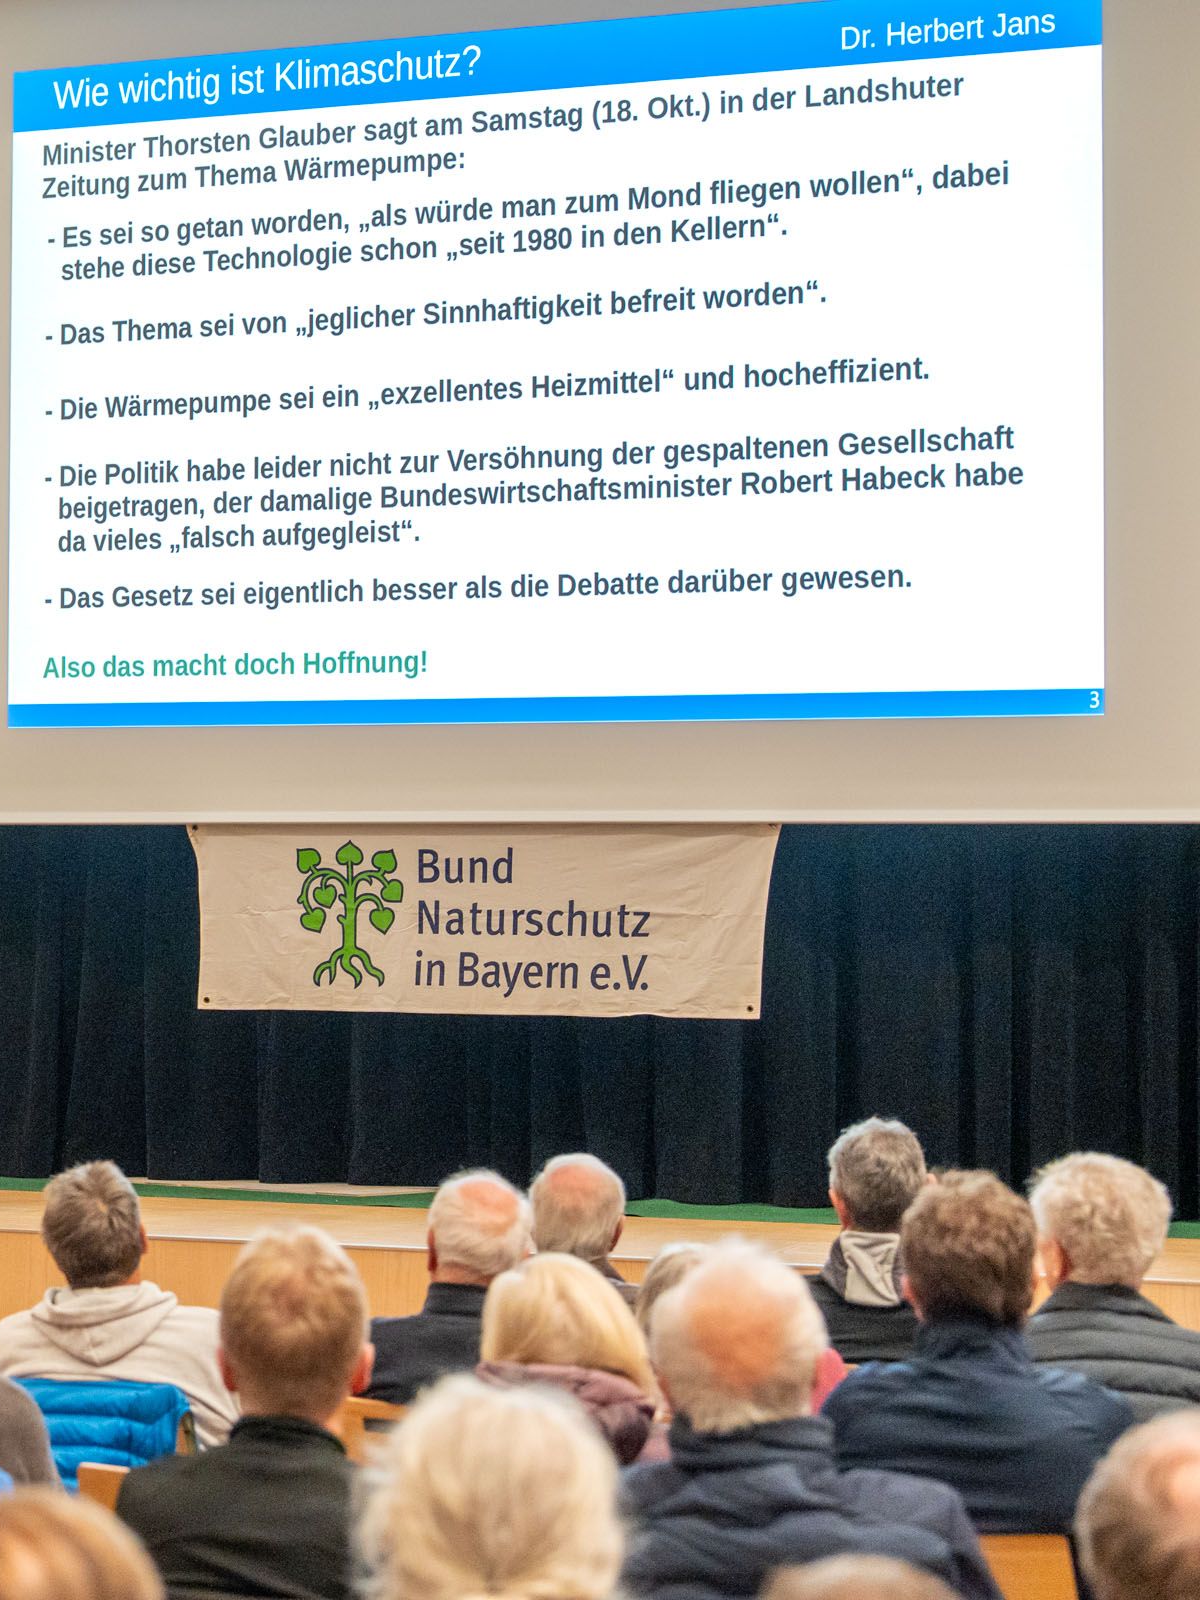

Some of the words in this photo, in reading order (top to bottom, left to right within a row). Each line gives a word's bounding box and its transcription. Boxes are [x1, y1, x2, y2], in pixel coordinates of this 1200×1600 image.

[841, 26, 875, 50] Dr.
[887, 16, 984, 46] Herbert
[992, 13, 1056, 38] Jans
[53, 77, 109, 109] Wie
[118, 67, 220, 105] wichtig
[231, 65, 265, 95] ist
[275, 44, 481, 92] Klimaschutz?
[43, 140, 137, 167] Minister
[142, 131, 251, 159] Thorsten
[258, 122, 357, 149] Glauber
[363, 116, 418, 146] sagt
[424, 116, 463, 137] am
[471, 105, 583, 134] Samstag
[592, 99, 639, 131] (18.
[647, 91, 711, 123] Okt.)
[720, 90, 744, 115] in
[752, 86, 797, 112] der
[805, 75, 965, 108] Landshuter
[42, 174, 130, 200] Zeitung
[137, 171, 187, 192] zum
[194, 163, 278, 188] Thema
[283, 151, 465, 182] Wärmepumpe:
[63, 225, 92, 248] Es
[99, 220, 133, 246] sei
[140, 224, 170, 243] so
[176, 217, 244, 247] getan
[250, 208, 350, 236] worden,
[359, 203, 407, 233] „als
[414, 196, 494, 225] würde
[501, 197, 556, 219] man
[564, 193, 619, 215] zum
[628, 181, 701, 211] Mond
[709, 178, 801, 209] fliegen
[809, 167, 923, 198] wollen“,
[932, 159, 1009, 190] dabei
[61, 255, 125, 281] stehe
[132, 252, 196, 277] diese
[202, 240, 353, 272] Technologie
[360, 236, 437, 263] schon
[446, 230, 505, 262] „seit
[513, 226, 573, 253] 1980
[581, 224, 605, 249] in
[613, 221, 662, 247] den
[671, 212, 788, 243] Kellern“.
[60, 323, 105, 346] Das
[111, 318, 193, 343] Thema
[199, 312, 235, 338] sei
[241, 315, 287, 336] von
[295, 304, 416, 338] „jeglicher
[423, 291, 603, 325] Sinnhaftigkeit
[610, 286, 696, 315] befreit
[702, 279, 827, 310] worden“.
[60, 396, 98, 421] Die
[104, 393, 272, 421] Wärmepumpe
[279, 385, 315, 411] sei
[322, 383, 359, 408] ein
[368, 378, 523, 411] „exzellentes
[531, 367, 674, 399] Heizmittel“
[684, 364, 735, 391] und
[744, 356, 929, 389] hocheffizient.
[60, 463, 98, 487] Die
[105, 459, 180, 486] Politik
[187, 457, 246, 483] habe
[253, 454, 323, 480] leider
[330, 451, 392, 477] nicht
[399, 454, 440, 474] zur
[446, 444, 603, 473] Versöhnung
[612, 440, 656, 466] der
[663, 435, 829, 470] gespaltenen
[838, 424, 1015, 456] Gesellschaft
[58, 495, 205, 525] beigetragen,
[213, 490, 253, 514] der
[260, 486, 373, 516] damalige
[380, 473, 733, 509] Bundeswirtschaftsminister
[741, 469, 833, 496] Robert
[841, 463, 946, 492] Habeck
[955, 460, 1024, 488] habe
[58, 529, 87, 553] da
[92, 527, 162, 552] vieles
[169, 523, 255, 554] „falsch
[262, 519, 420, 552] aufgegleist“.
[60, 587, 105, 609] Das
[112, 585, 194, 608] Gesetz
[200, 581, 235, 606] sei
[243, 578, 364, 611] eigentlich
[372, 577, 459, 602] besser
[465, 574, 503, 600] als
[510, 573, 550, 598] die
[558, 571, 660, 597] Debatte
[667, 567, 773, 594] darüber
[781, 568, 912, 598] gewesen.
[42, 655, 96, 679] Also
[102, 654, 145, 678] das
[153, 652, 228, 677] macht
[234, 651, 295, 676] doch
[303, 649, 427, 680] Hoffnung!
[1088, 690, 1101, 709] 3
[416, 846, 514, 884] Bund
[416, 899, 651, 938] Naturschutz
[413, 950, 446, 988] in
[458, 951, 580, 998] Bayern
[589, 954, 649, 992] e.V.
